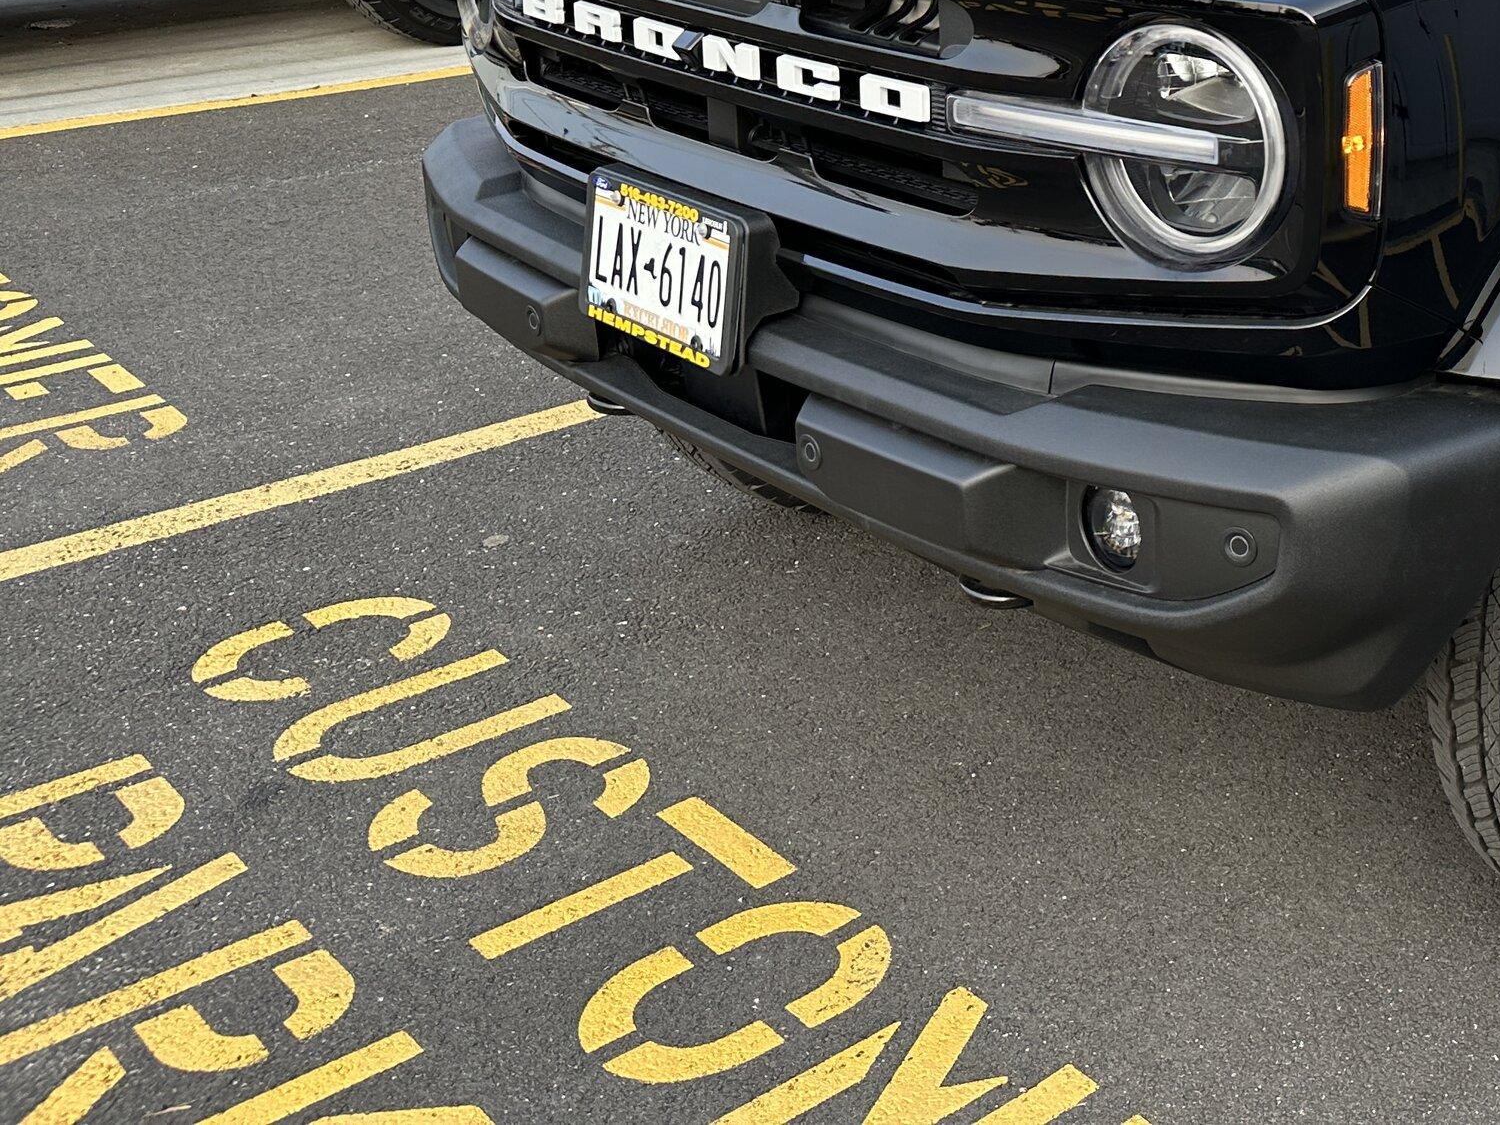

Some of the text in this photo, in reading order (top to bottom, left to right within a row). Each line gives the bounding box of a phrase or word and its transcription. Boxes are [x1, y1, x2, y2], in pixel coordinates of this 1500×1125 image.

[627, 199, 700, 246] NEW YORK
[587, 305, 711, 368] HEMPSTEAD
